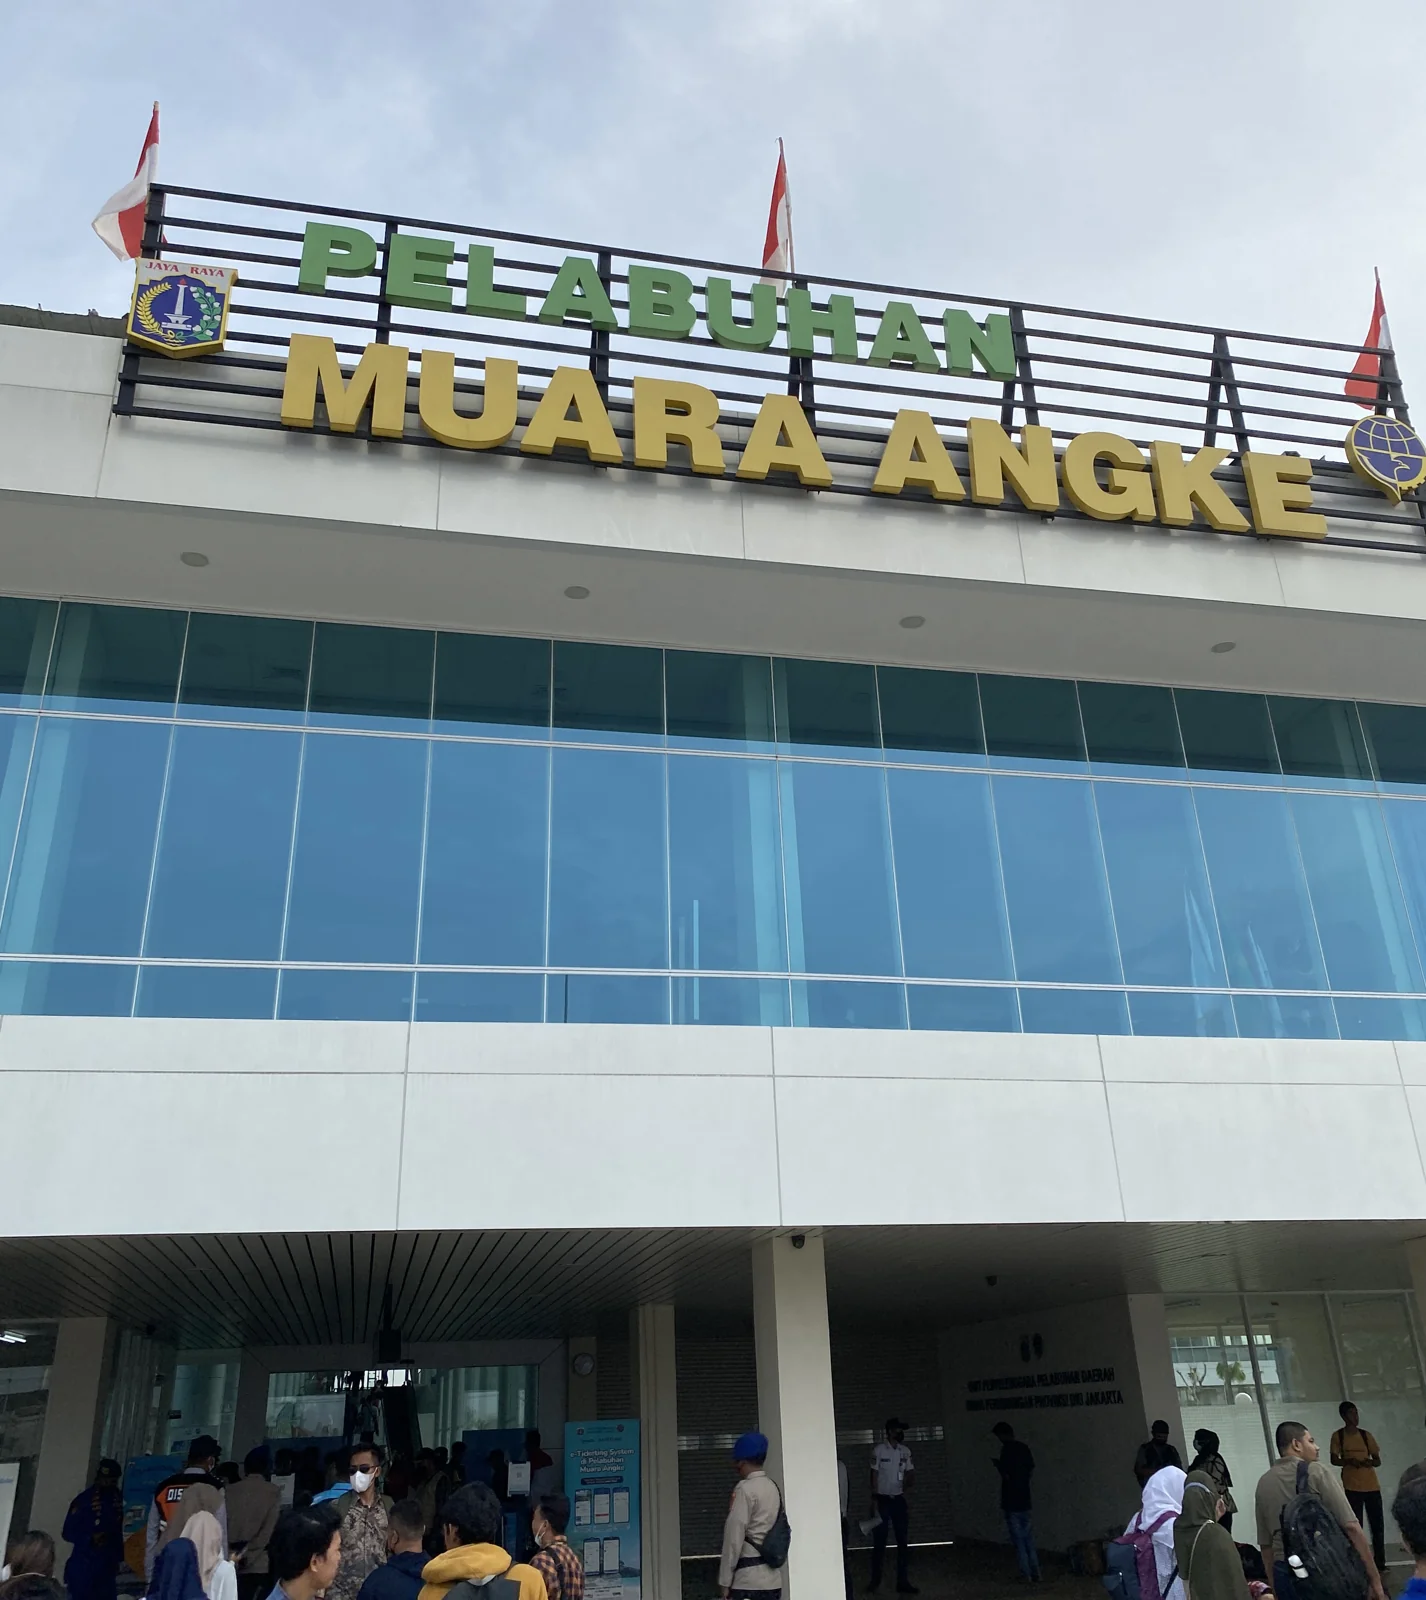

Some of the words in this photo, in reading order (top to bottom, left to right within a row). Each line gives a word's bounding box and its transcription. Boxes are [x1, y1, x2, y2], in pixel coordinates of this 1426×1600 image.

[145, 261, 179, 273] JAYA
[190, 266, 225, 278] RAYA
[298, 221, 1016, 381] PELABUHAN
[280, 333, 833, 488] MUARA
[872, 409, 1328, 540] ANGKE
[1081, 1367, 1115, 1383] DAERAH
[1085, 1390, 1124, 1406] JAKARTA
[609, 1448, 635, 1457] System
[579, 1465, 602, 1473] Muara
[588, 1457, 625, 1465] Pelabuhan
